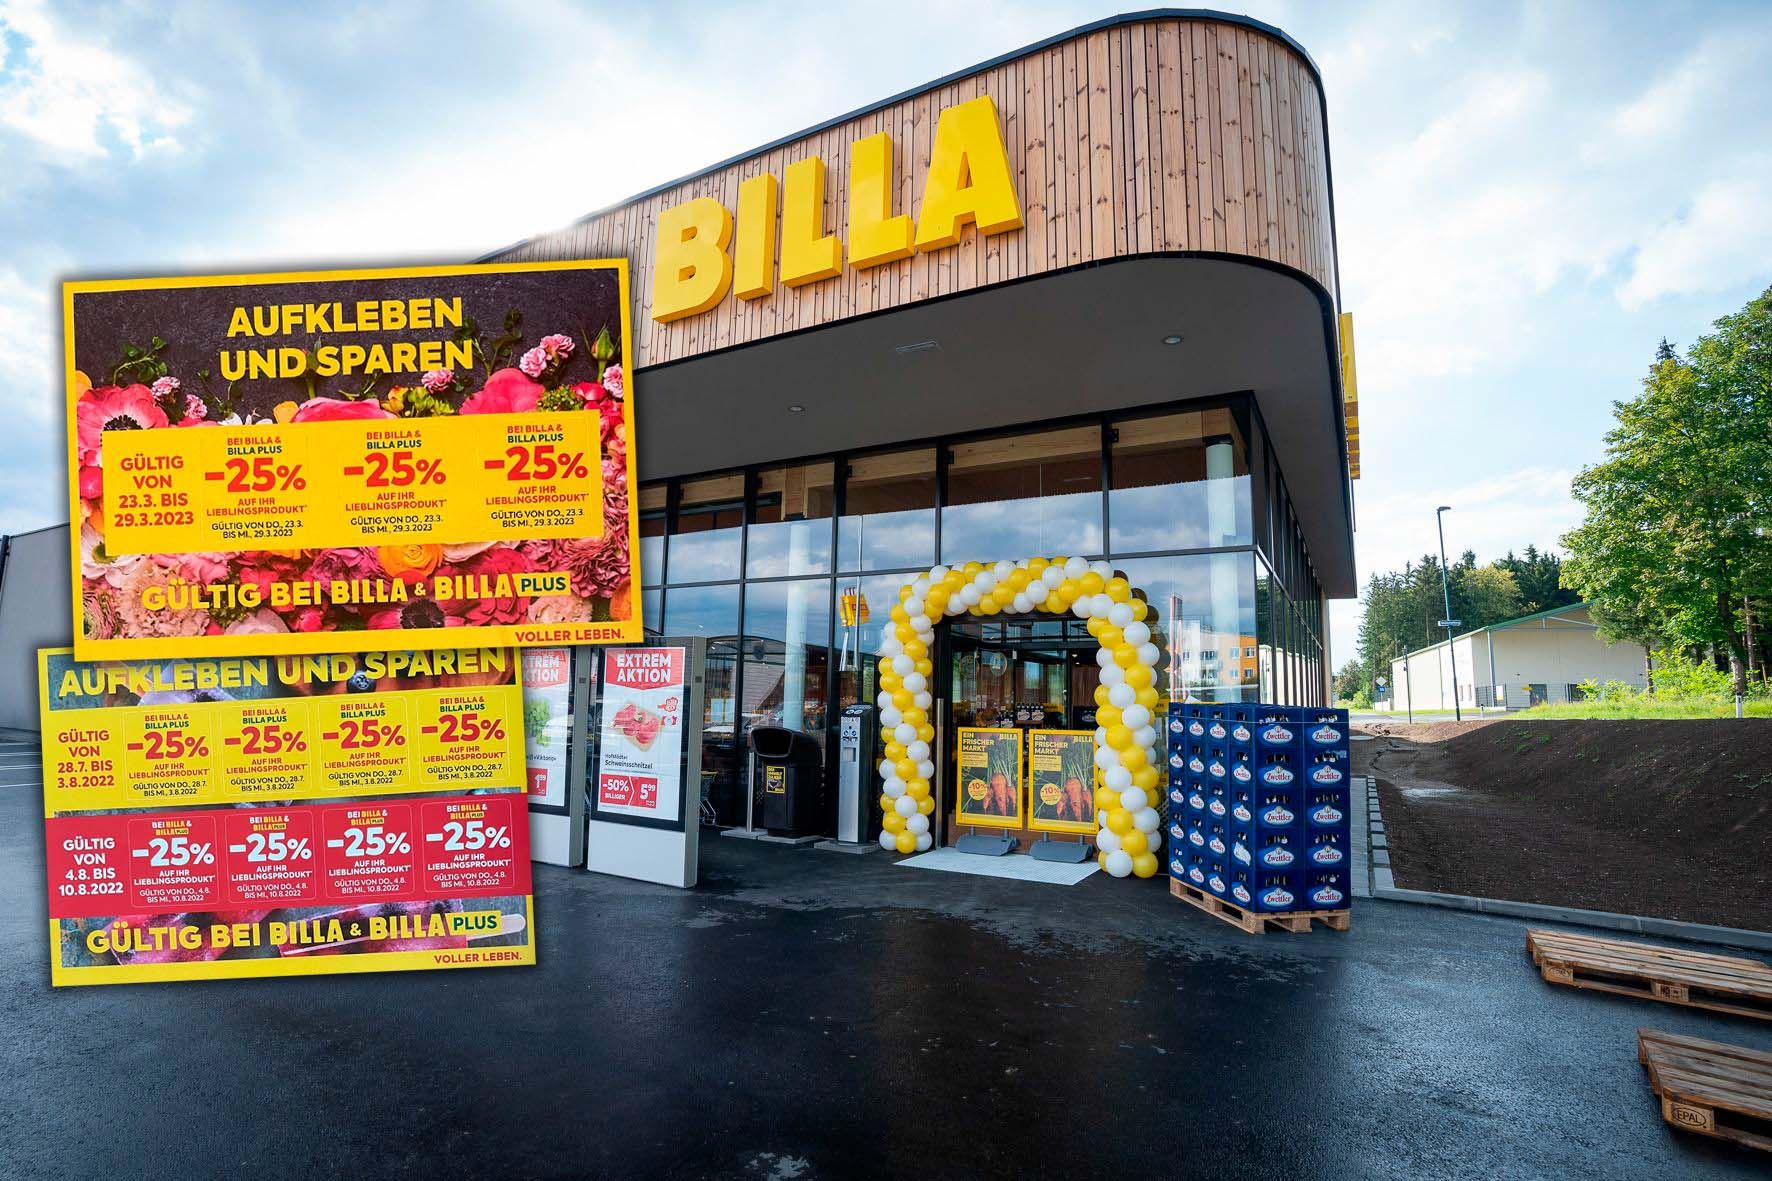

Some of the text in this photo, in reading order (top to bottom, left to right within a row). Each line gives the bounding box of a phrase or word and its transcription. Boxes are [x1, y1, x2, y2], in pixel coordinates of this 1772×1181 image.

[651, 95, 1024, 324] BILLA
[522, 655, 560, 668] XTREM
[616, 653, 672, 668] EXTREM
[523, 669, 560, 682] KTION
[617, 668, 672, 683] AKTION
[1266, 732, 1290, 741] Zwettler
[1314, 732, 1339, 741] Zwettler
[1267, 772, 1291, 782] Zwettler
[1315, 772, 1339, 781] Zwettler
[602, 779, 629, 792] -50%
[1267, 813, 1292, 822] Zwettler
[1315, 812, 1339, 821] Zwettler
[1267, 853, 1292, 862] Zwettler
[1315, 852, 1340, 861] Zwettler
[1267, 894, 1291, 903] Zwettler
[1315, 893, 1340, 901] Zwettler
[1676, 1110, 1701, 1124] EPAL
